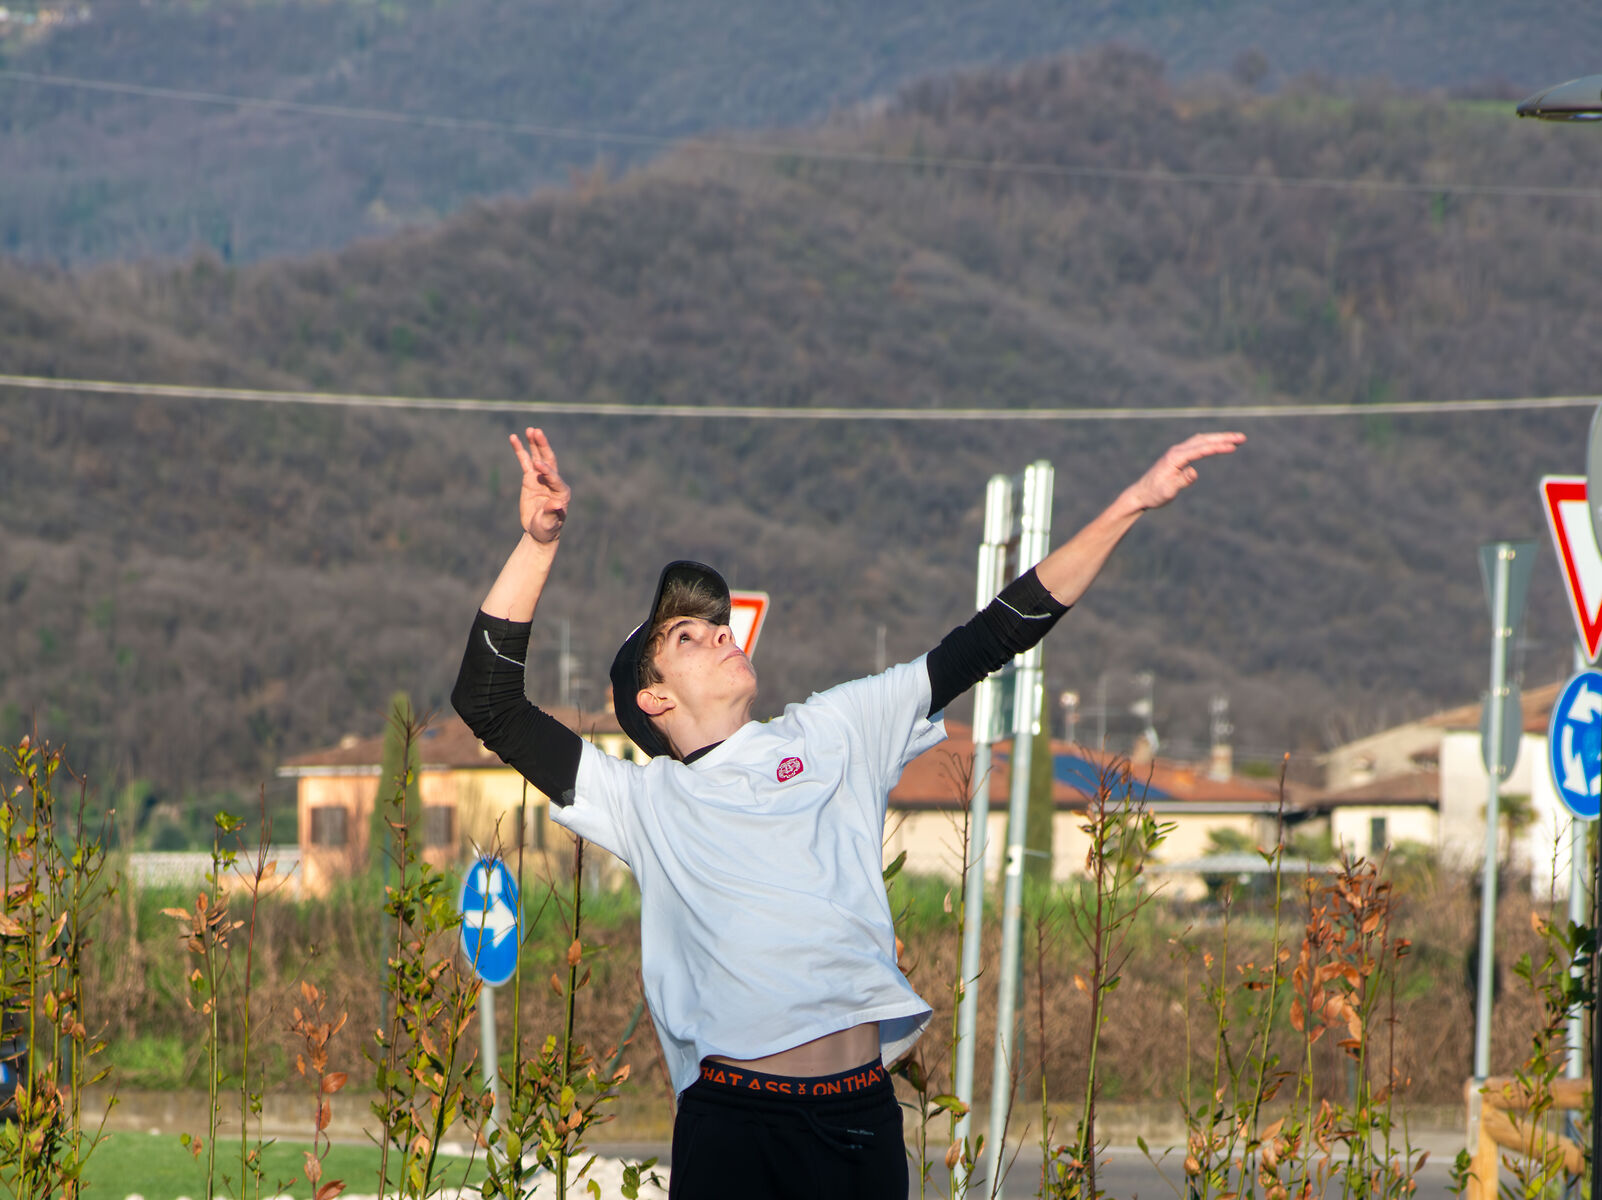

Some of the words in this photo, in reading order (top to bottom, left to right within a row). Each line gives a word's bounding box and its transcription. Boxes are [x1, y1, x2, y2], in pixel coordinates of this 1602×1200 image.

[748, 1078, 791, 1094] ASS
[813, 1080, 841, 1096] ON
[843, 1064, 885, 1093] THAT
